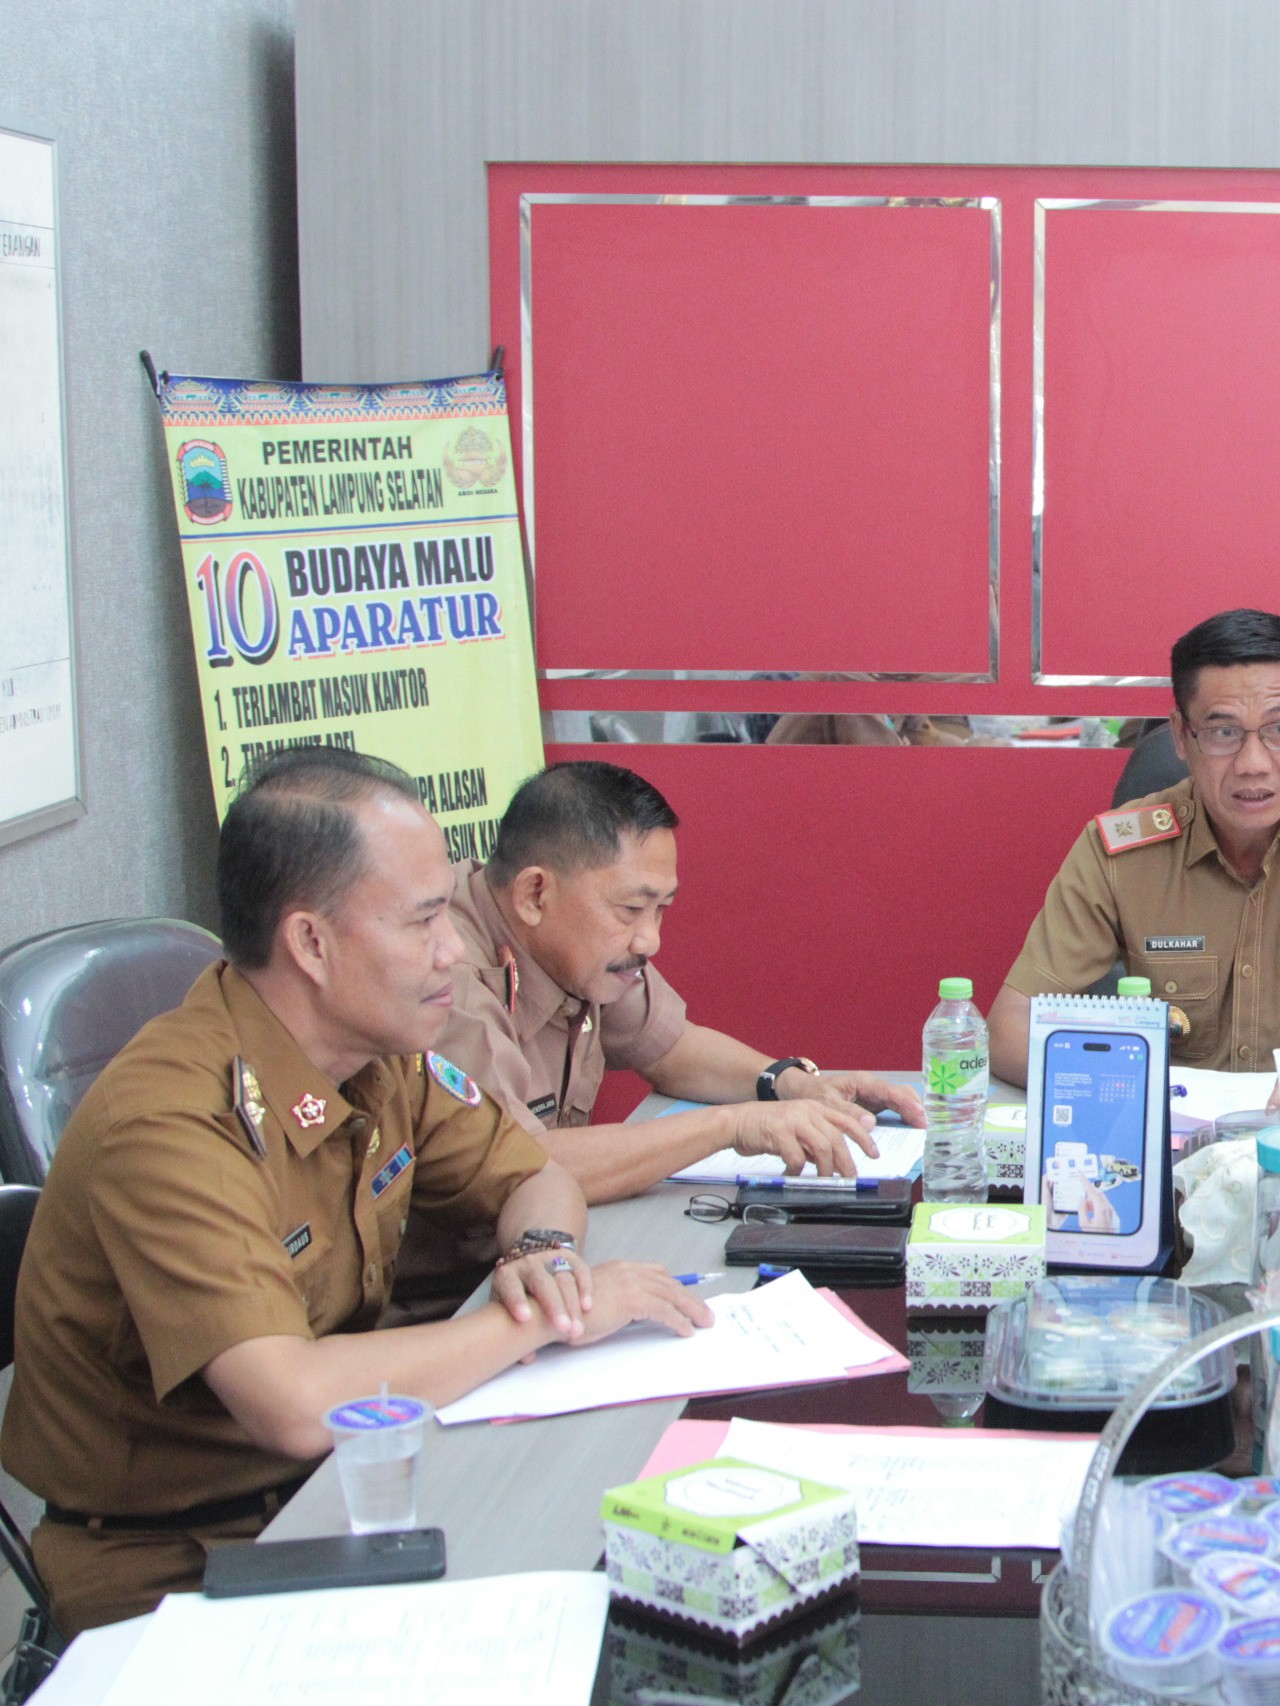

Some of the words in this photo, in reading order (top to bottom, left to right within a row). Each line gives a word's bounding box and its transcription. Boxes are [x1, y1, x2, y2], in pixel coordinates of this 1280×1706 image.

[0, 233, 41, 257] ERANGAN
[262, 436, 413, 465] PEMERINTAH
[237, 475, 319, 519] KABUPATEN
[320, 471, 384, 515] LAMPUNG
[387, 468, 444, 511] SELATAN
[285, 543, 410, 597] BUDAYA
[414, 536, 495, 585] MALU
[197, 551, 277, 662] 10
[288, 592, 503, 656] APARATUR
[214, 689, 227, 731] 1.
[232, 679, 318, 728] TERLAMBAT
[319, 673, 374, 719] MASUK
[371, 667, 430, 712] KANTOR
[221, 745, 236, 788] 2.
[439, 767, 488, 813] ALASAN
[443, 822, 479, 865] ASUK
[1151, 940, 1198, 949] DULKAHAR
